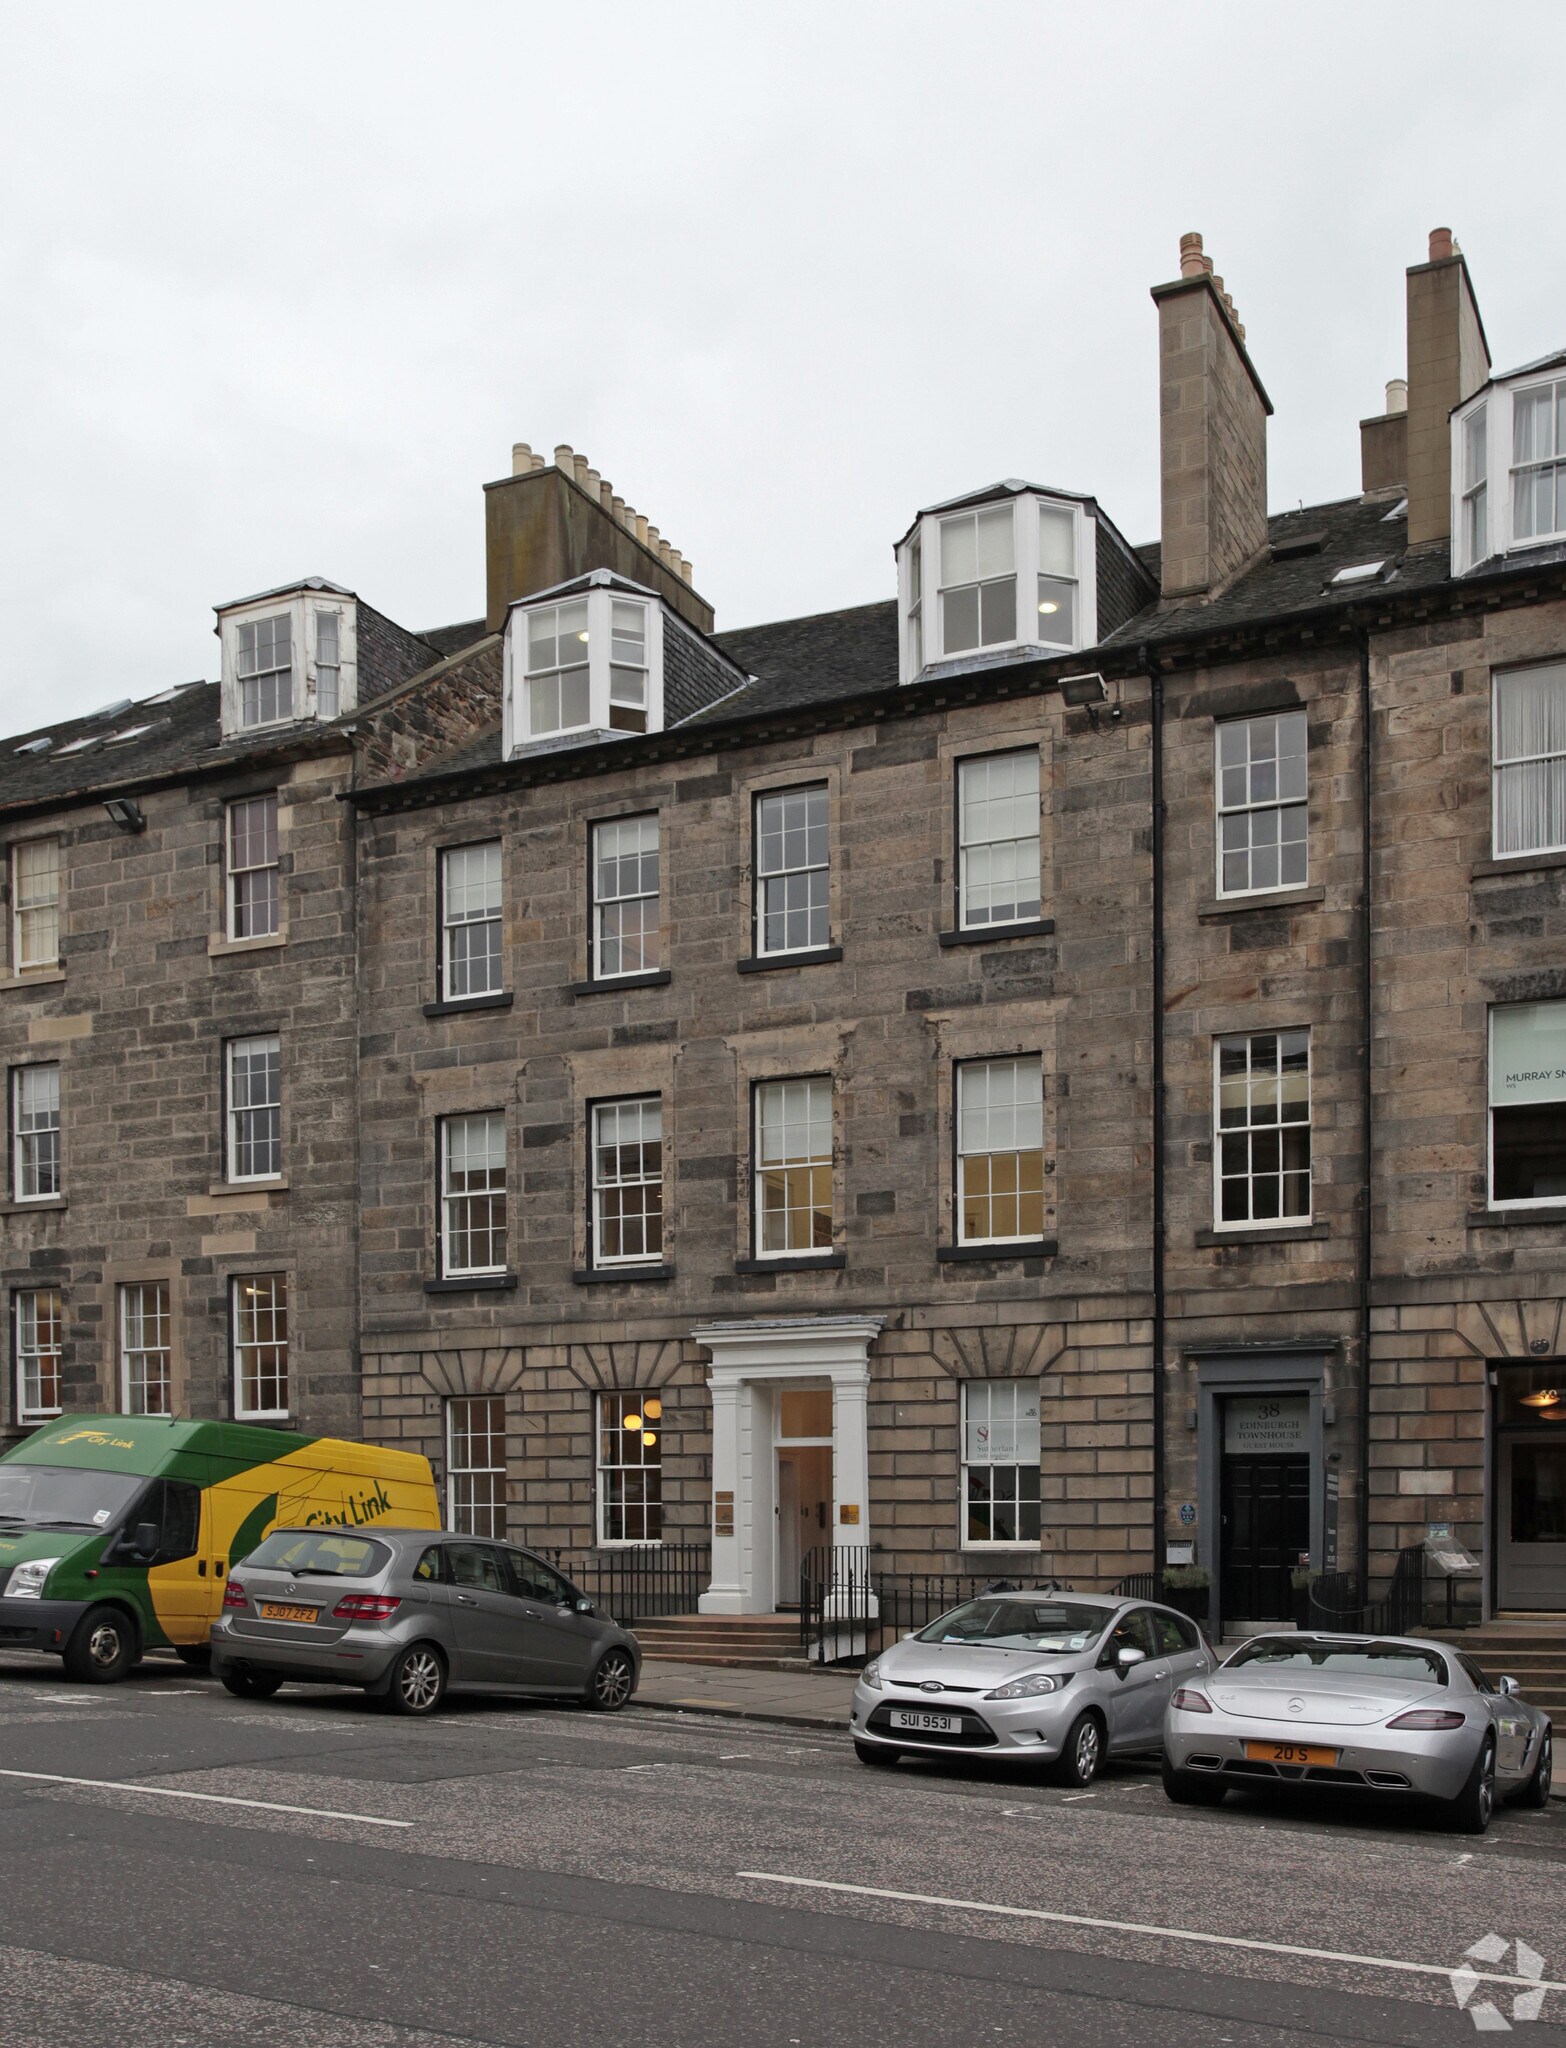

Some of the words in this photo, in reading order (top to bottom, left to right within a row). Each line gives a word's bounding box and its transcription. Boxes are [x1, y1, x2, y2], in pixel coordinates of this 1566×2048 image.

[1506, 1070, 1552, 1082] MURRAY
[1258, 1402, 1280, 1420] 38
[1240, 1421, 1299, 1430] EDINBURGH
[88, 1436, 109, 1445] City
[110, 1439, 134, 1449] Link
[1237, 1431, 1302, 1439] TOWNHOUSE
[349, 1479, 392, 1525] Link
[266, 1605, 293, 1618] SJ07
[293, 1608, 314, 1620] ZFZ
[923, 1715, 951, 1730] 9531
[1273, 1746, 1294, 1760] 20
[1298, 1748, 1308, 1761] S
